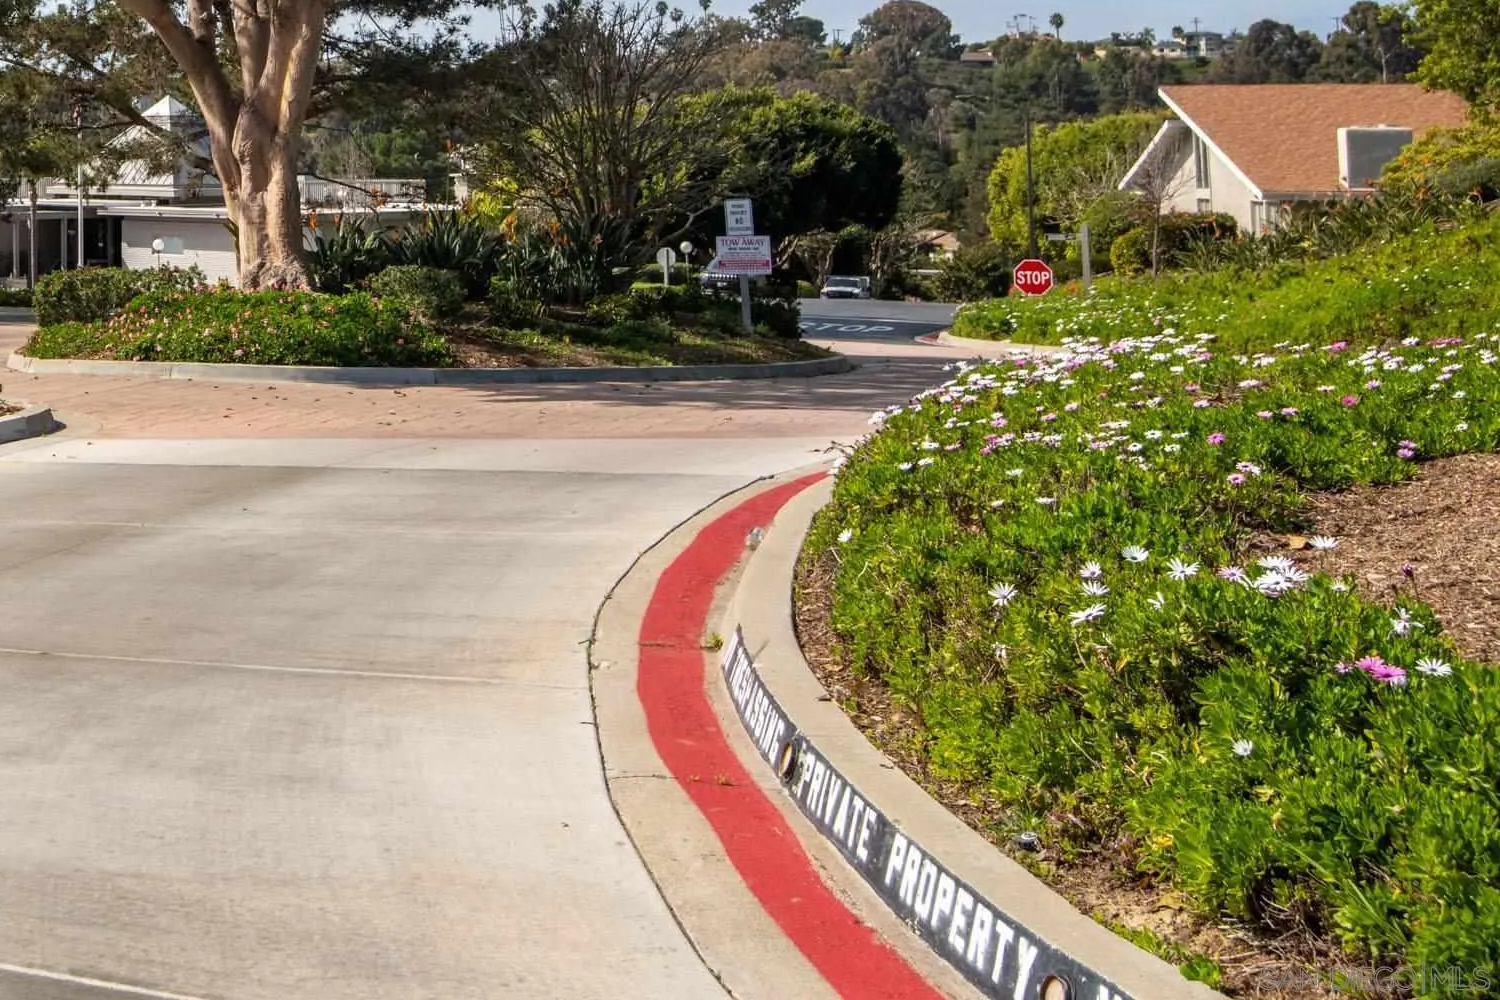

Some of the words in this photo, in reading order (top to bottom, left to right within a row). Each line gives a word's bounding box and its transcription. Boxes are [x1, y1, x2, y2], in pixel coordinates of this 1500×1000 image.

[721, 238, 740, 247] TOW
[741, 238, 765, 247] AWAY
[1016, 270, 1050, 285] STOP
[797, 751, 877, 863] PRIVATE
[884, 832, 1038, 1000] PROPERTY
